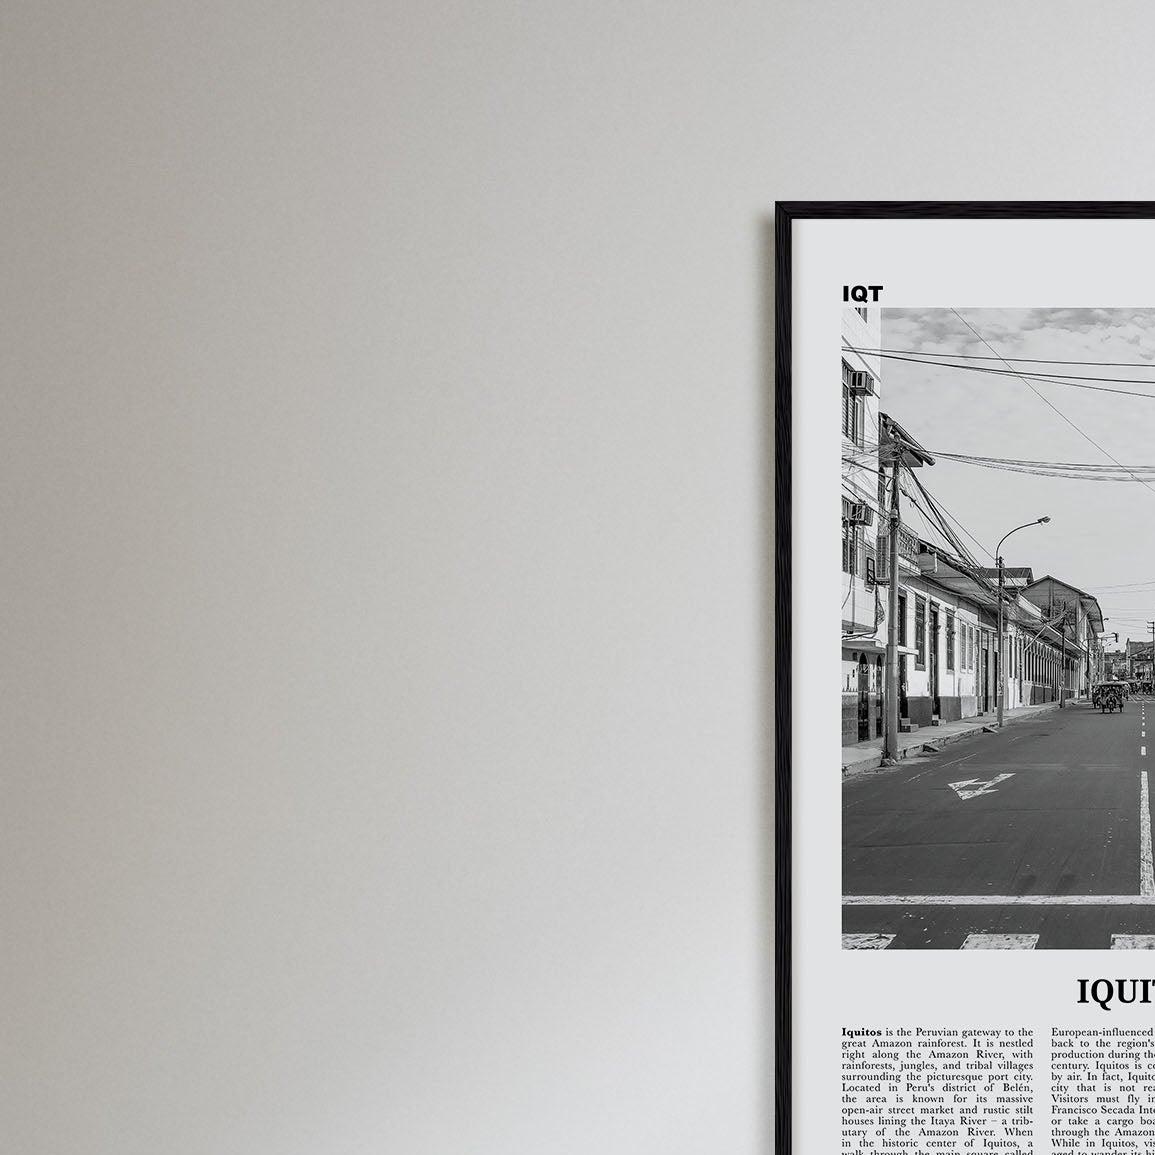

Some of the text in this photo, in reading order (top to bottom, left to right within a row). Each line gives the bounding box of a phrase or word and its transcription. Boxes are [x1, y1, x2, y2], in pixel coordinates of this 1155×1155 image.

[843, 285, 883, 303] IQT
[841, 1027, 1034, 1039] Iquitos is the Peruvian gateway to the
[1051, 1027, 1154, 1039] European-influenced
[1051, 1038, 1074, 1048] back
[1095, 1038, 1111, 1048] the
[1117, 1038, 1155, 1050] region's
[842, 1049, 1033, 1061] right along the Amazon River, with
[842, 1061, 1034, 1072] rainforests, jungles, and tribal villages
[1051, 1061, 1090, 1072] century.
[1095, 1061, 1130, 1072] Iquitos
[1134, 1061, 1142, 1070] is
[841, 1072, 1033, 1083] surrounding the picturesque port city.
[842, 1083, 1034, 1093] Located in Peru's district of Belén,
[1051, 1083, 1069, 1094] city
[1076, 1083, 1096, 1092] that
[1104, 1083, 1112, 1092] is
[1052, 1094, 1089, 1103] Visitors
[1127, 1094, 1140, 1105] fly
[841, 1105, 883, 1116] open-air
[920, 1105, 954, 1114] market
[959, 1105, 978, 1114] and
[983, 1105, 1010, 1114] rustic
[1015, 1105, 1033, 1114] stilt
[1051, 1105, 1098, 1114] Francisco
[1100, 1105, 1135, 1114] Secada
[842, 1127, 1033, 1139] utary of the Amazon River. When
[1052, 1138, 1080, 1148] While
[1086, 1138, 1096, 1148] in
[1102, 1138, 1138, 1150] Iquitos,
